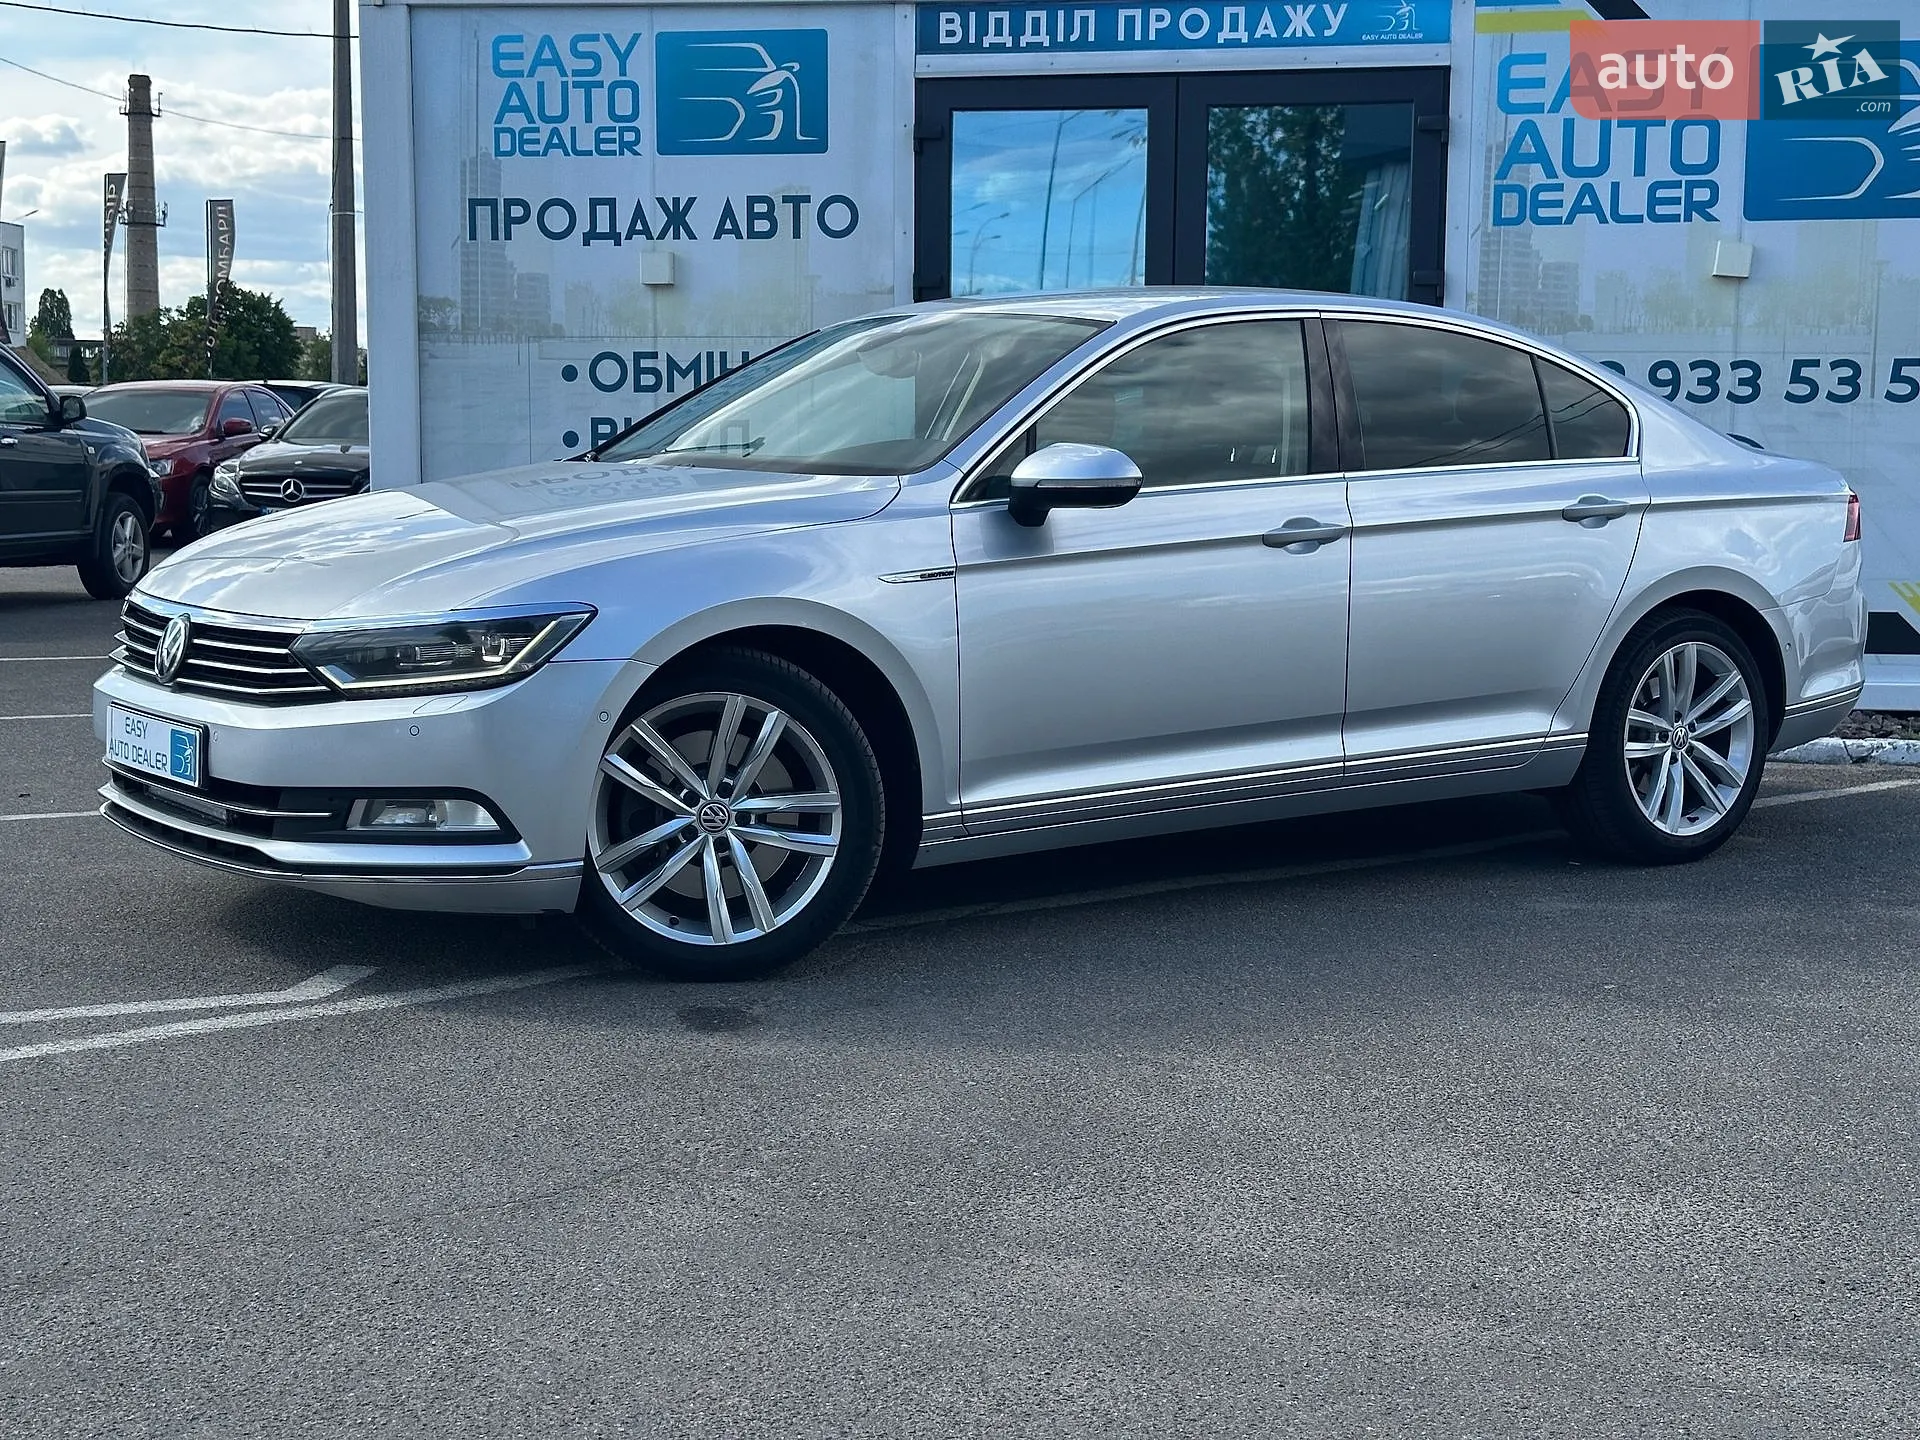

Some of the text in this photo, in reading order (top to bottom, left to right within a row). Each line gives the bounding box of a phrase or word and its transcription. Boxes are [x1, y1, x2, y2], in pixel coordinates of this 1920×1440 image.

[938, 3, 1349, 48] ВІДДІЛ ПРОДАЖУ
[1361, 33, 1379, 41] EASY
[1398, 32, 1424, 40] DEALER
[491, 32, 643, 79] EASY
[493, 79, 640, 125] AUTO
[493, 125, 643, 158] DEALER
[1494, 113, 1721, 180] AUTO
[467, 194, 860, 247] ПРОДАЖ АВТО
[1492, 179, 1721, 227] DEALER
[1647, 359, 1763, 405] 933
[1783, 358, 1862, 404] 53
[125, 716, 149, 739] EASY
[108, 737, 169, 772] AUTO DEALER
